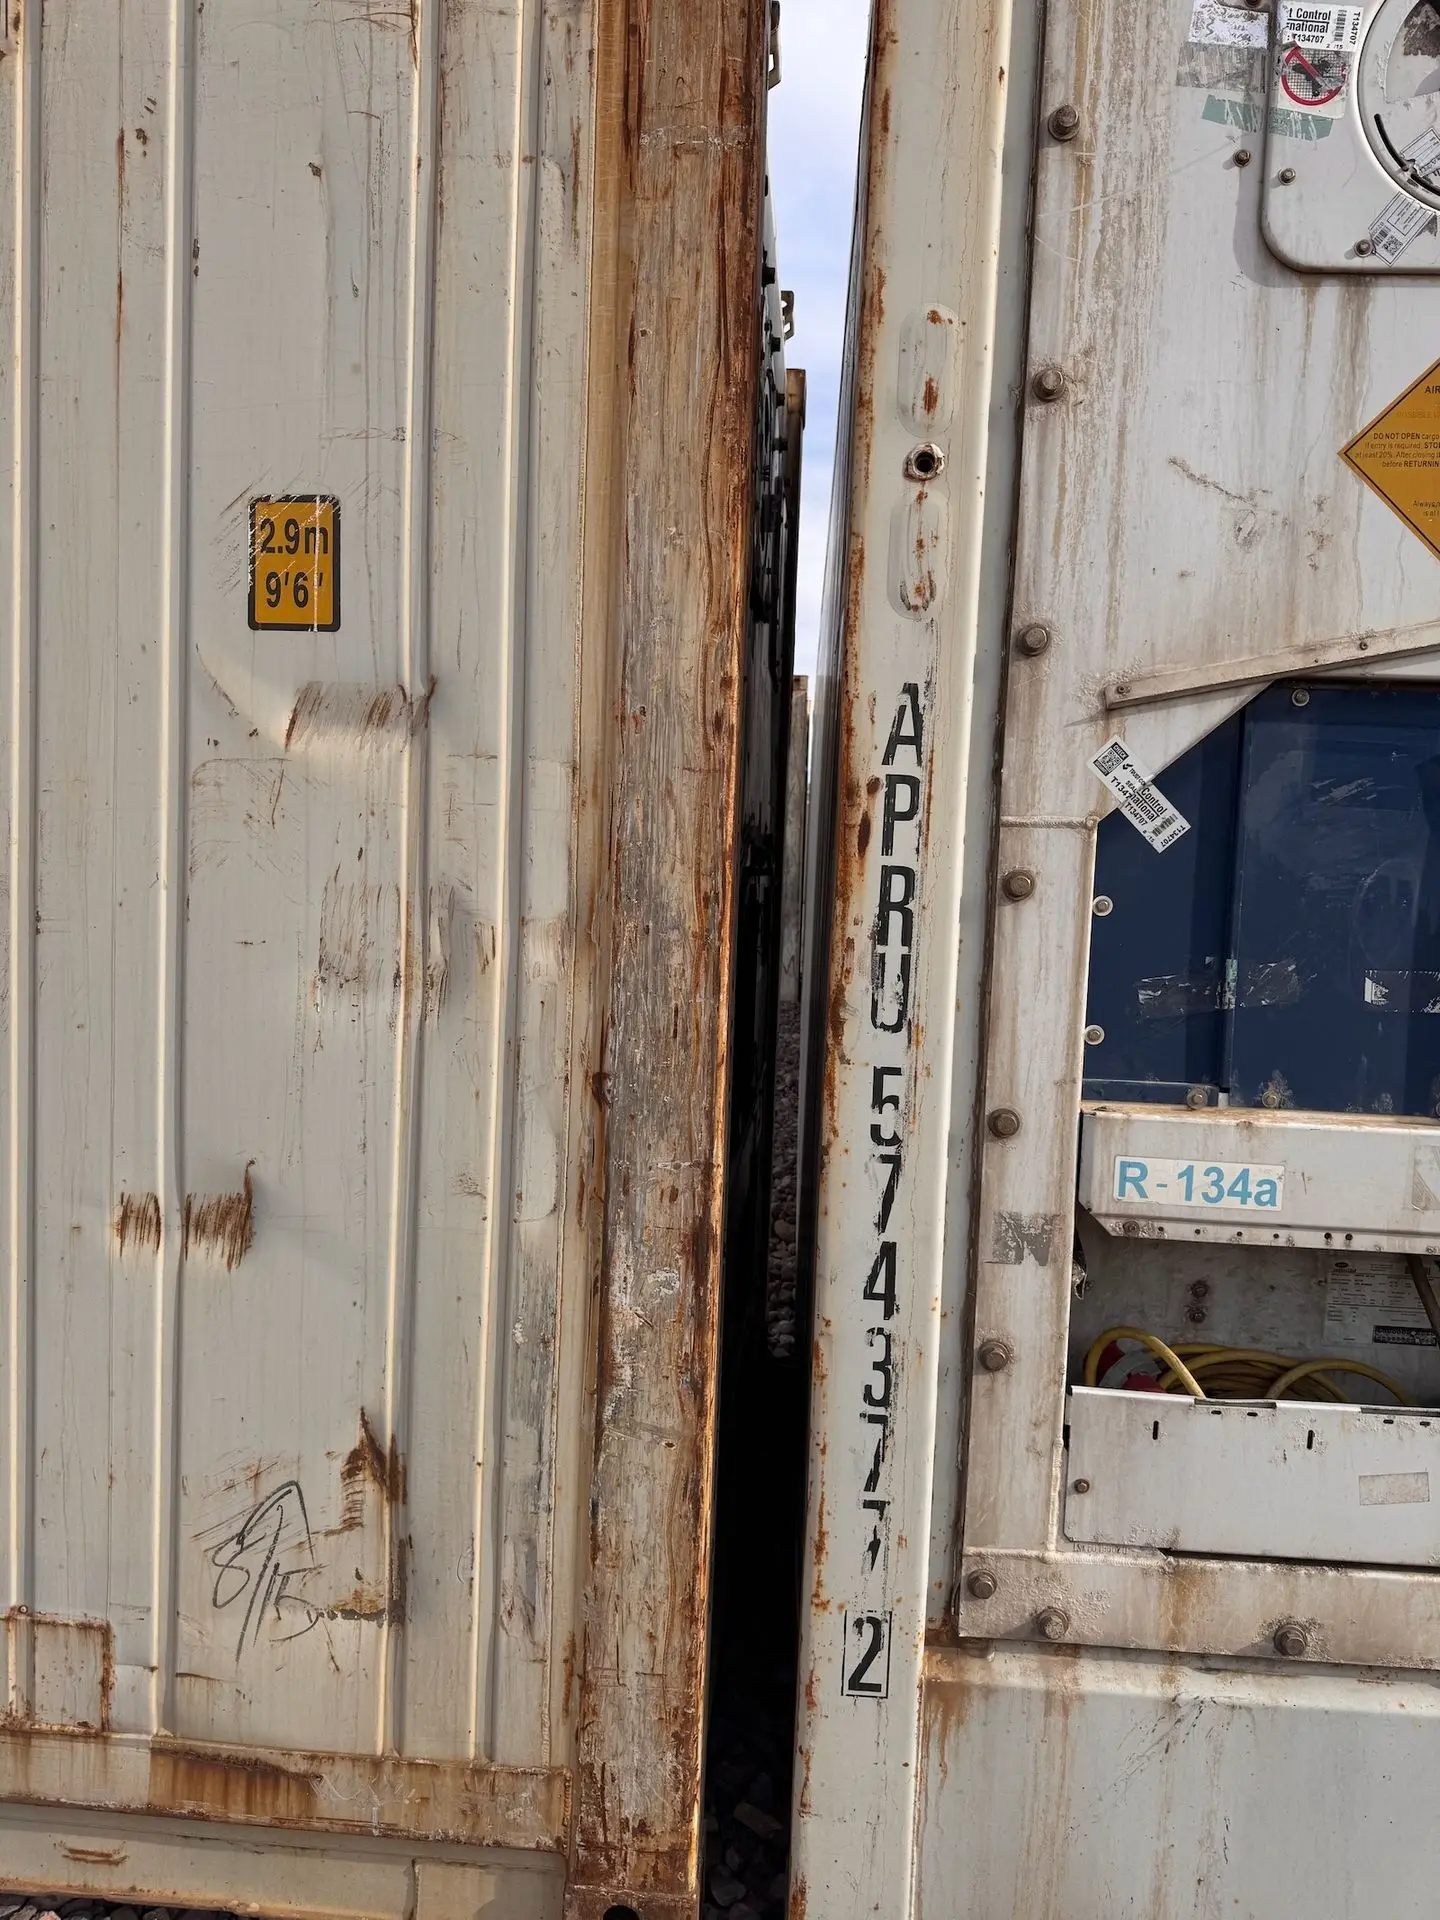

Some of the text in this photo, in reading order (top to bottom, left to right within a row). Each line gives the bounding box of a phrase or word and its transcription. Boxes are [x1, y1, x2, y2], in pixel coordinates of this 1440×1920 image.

[1296, 7, 1332, 21] Control
[1291, 33, 1325, 43] T134707
[1349, 11, 1361, 45] T134707
[1373, 432, 1384, 440] DO
[1385, 432, 1400, 440] NOT
[1401, 432, 1420, 440] OPEN
[1382, 460, 1403, 468] before
[1141, 787, 1168, 815] Control
[1124, 802, 1148, 826] T134707
[1160, 824, 1187, 848] T134707
[869, 682, 924, 1034] APRU
[847, 1615, 883, 1693] 2
